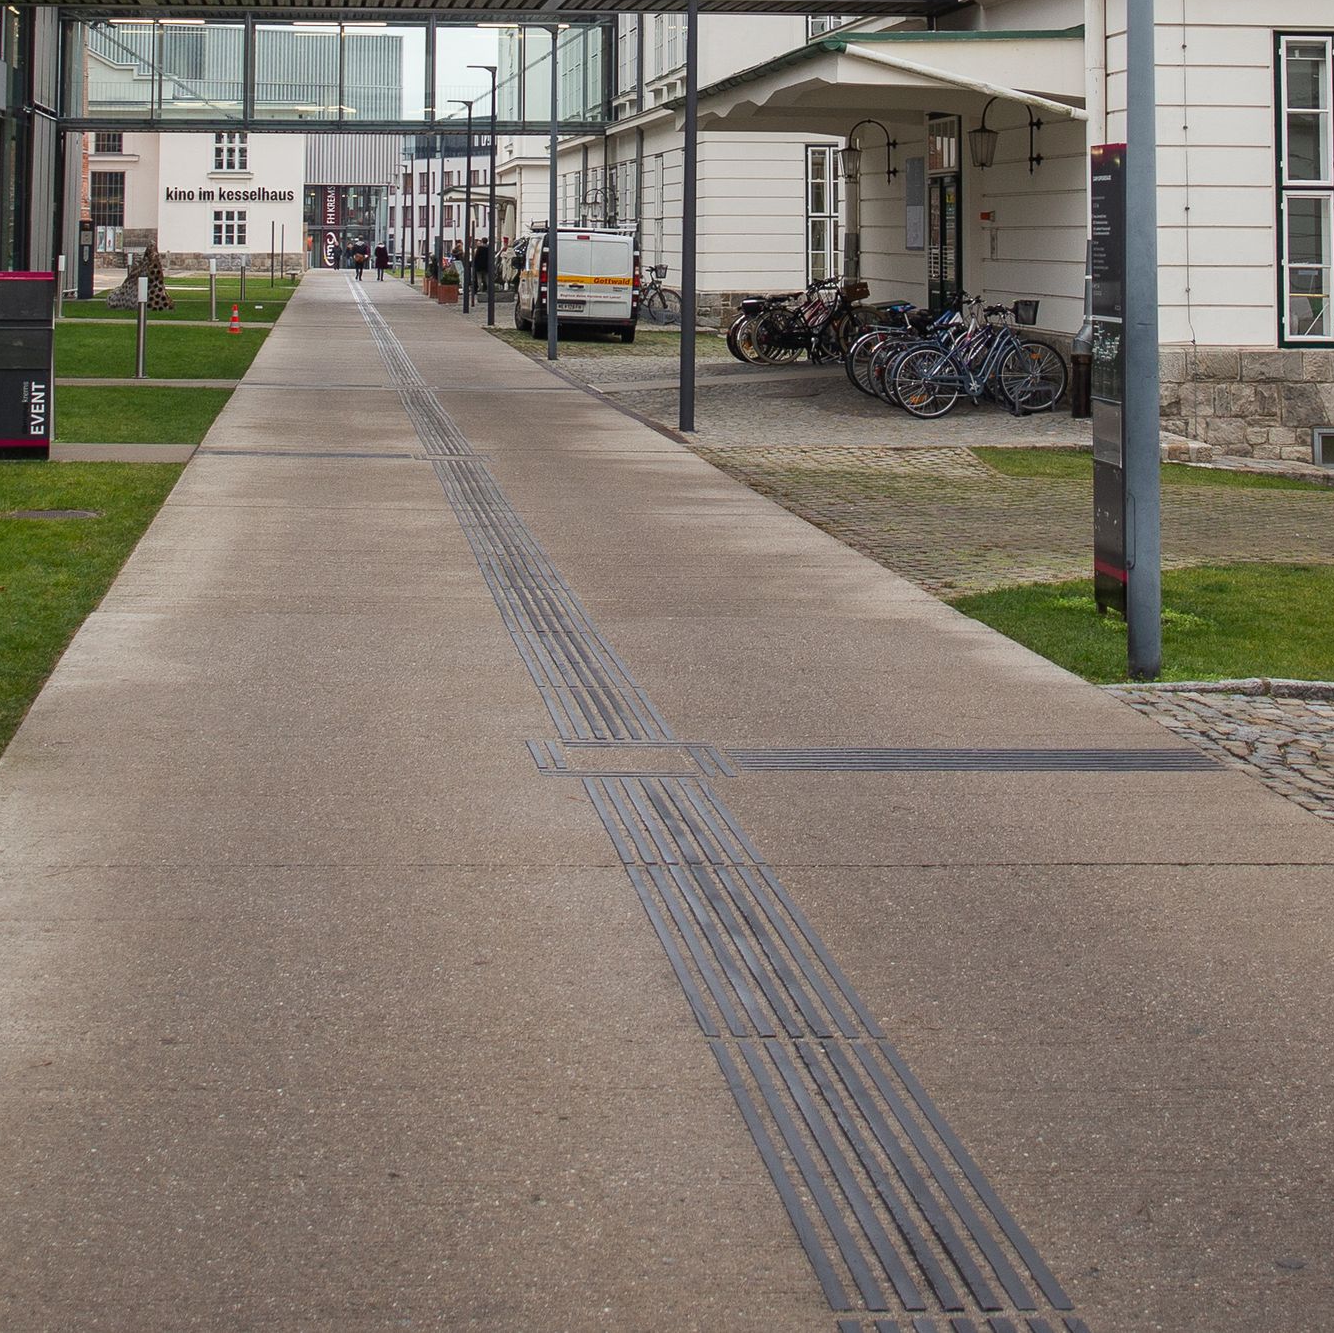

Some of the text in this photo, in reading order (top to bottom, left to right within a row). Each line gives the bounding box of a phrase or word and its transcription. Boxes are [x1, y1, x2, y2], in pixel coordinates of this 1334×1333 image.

[166, 187, 294, 201] kino im kesselhaus
[327, 186, 335, 213] KREMS
[327, 214, 335, 224] FH
[593, 277, 630, 286] Gottwald
[21, 381, 29, 403] krems
[30, 381, 45, 435] EVENT
